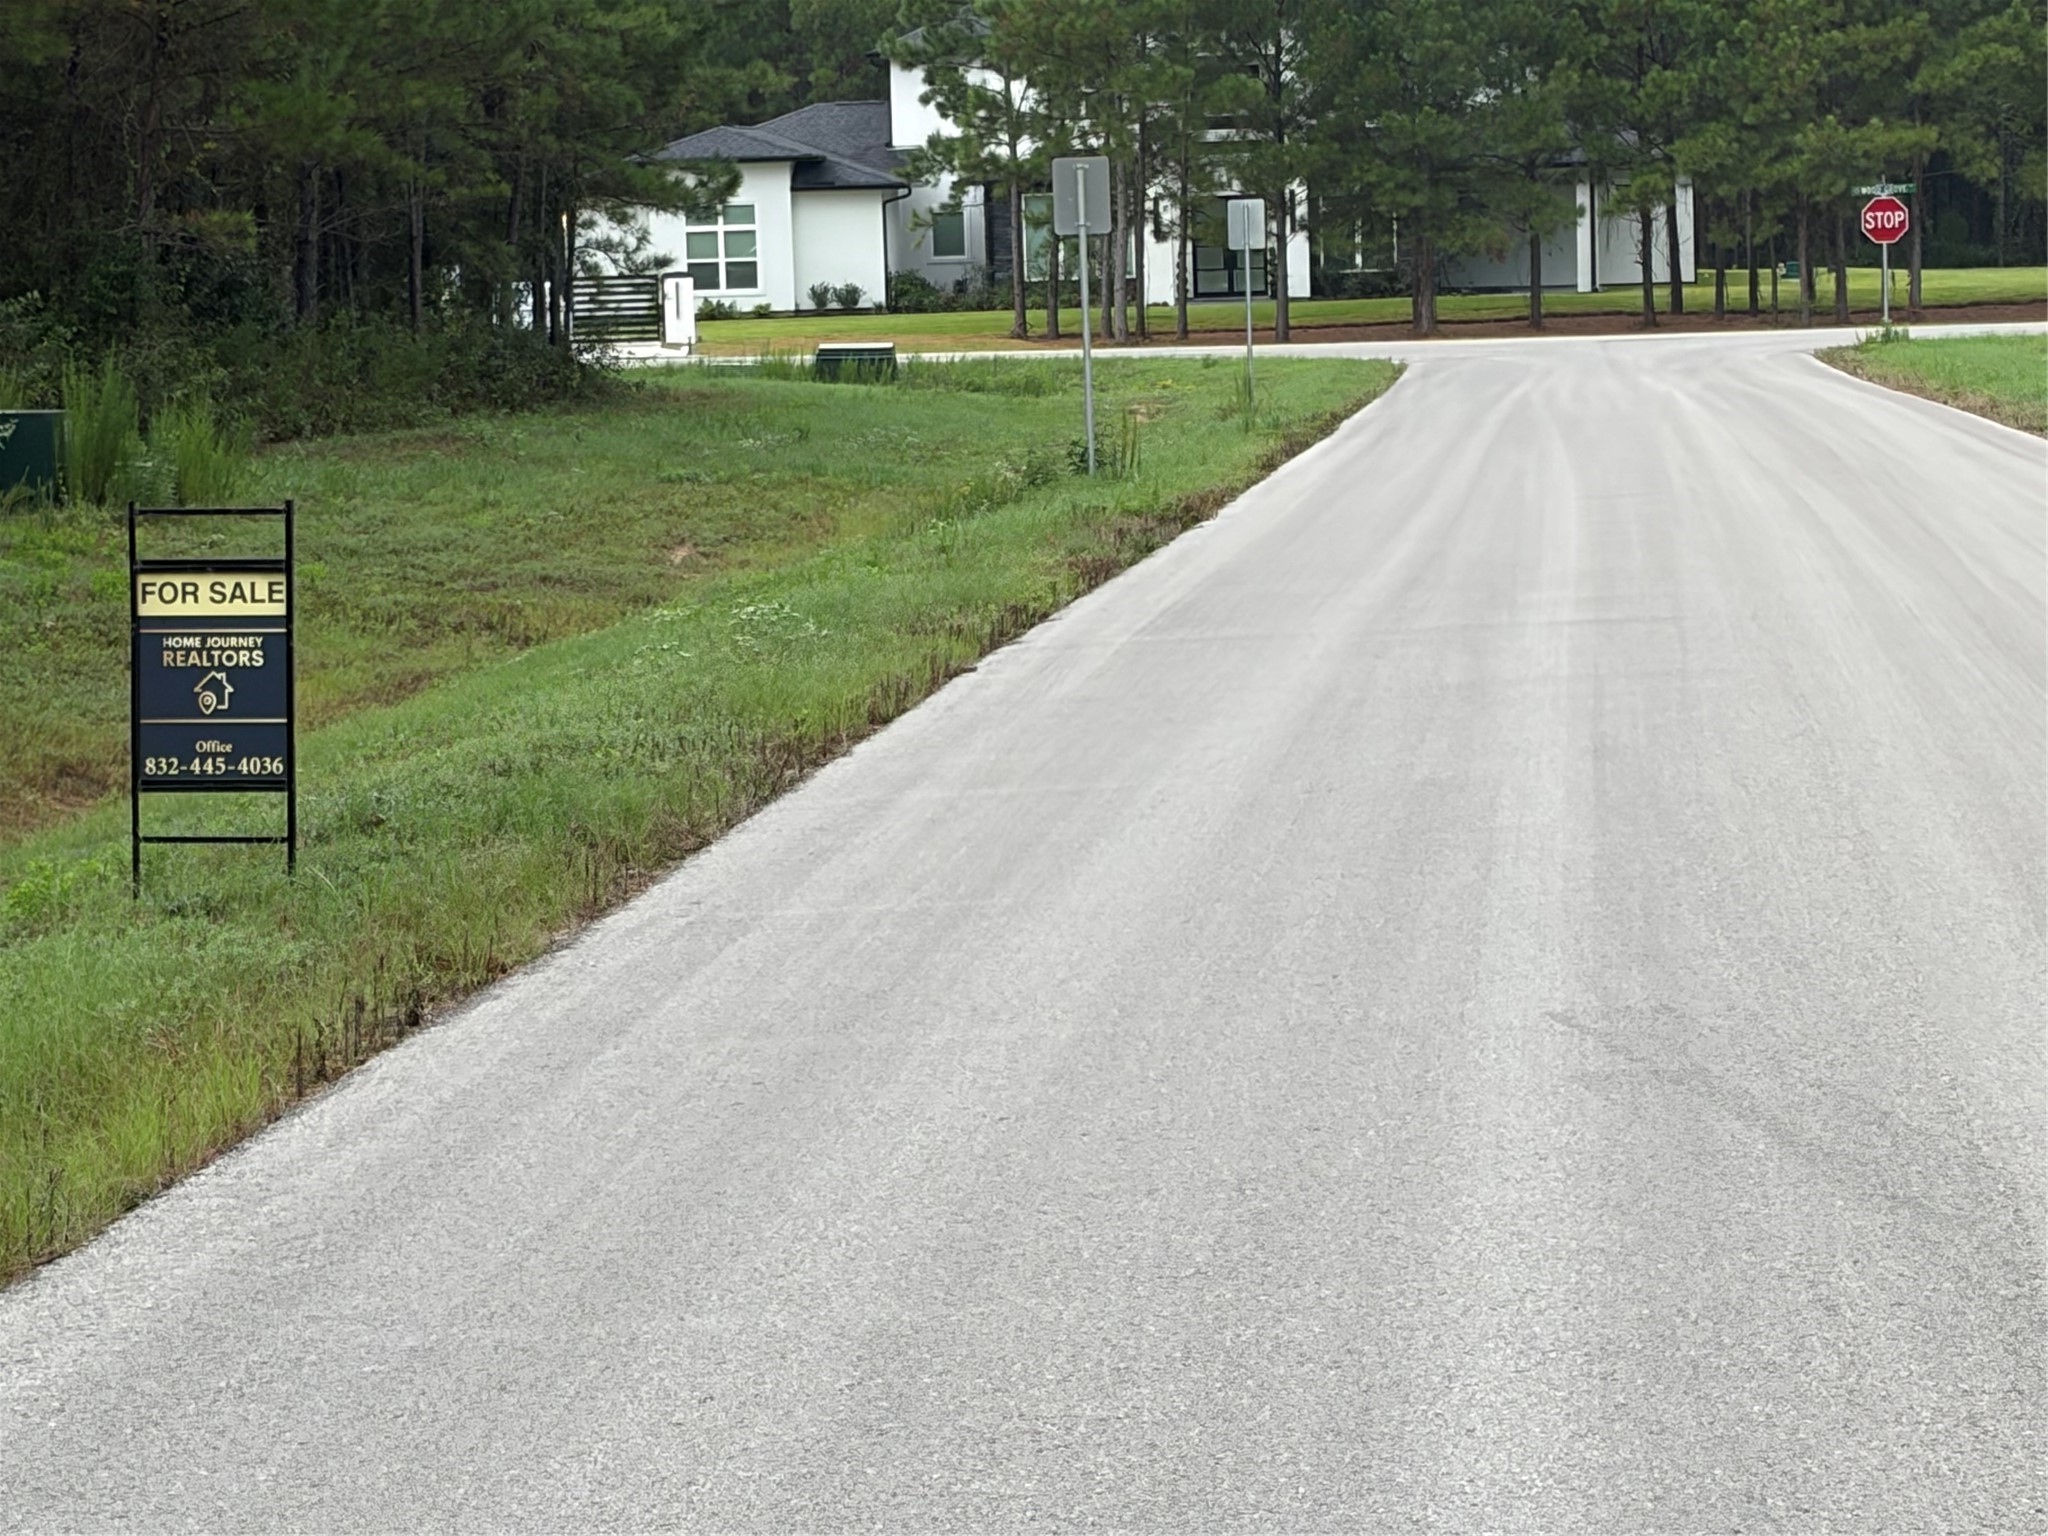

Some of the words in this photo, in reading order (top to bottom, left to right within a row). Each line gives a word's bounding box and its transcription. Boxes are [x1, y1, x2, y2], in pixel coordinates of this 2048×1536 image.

[1866, 211, 1904, 229] STOP
[141, 581, 199, 605] FOR
[209, 581, 285, 605] SALE
[163, 636, 202, 649] HOME
[205, 636, 264, 649] JOURNEY
[163, 650, 264, 667] REALTORS
[196, 740, 233, 752] Office
[145, 756, 284, 776] 832-445-4036
